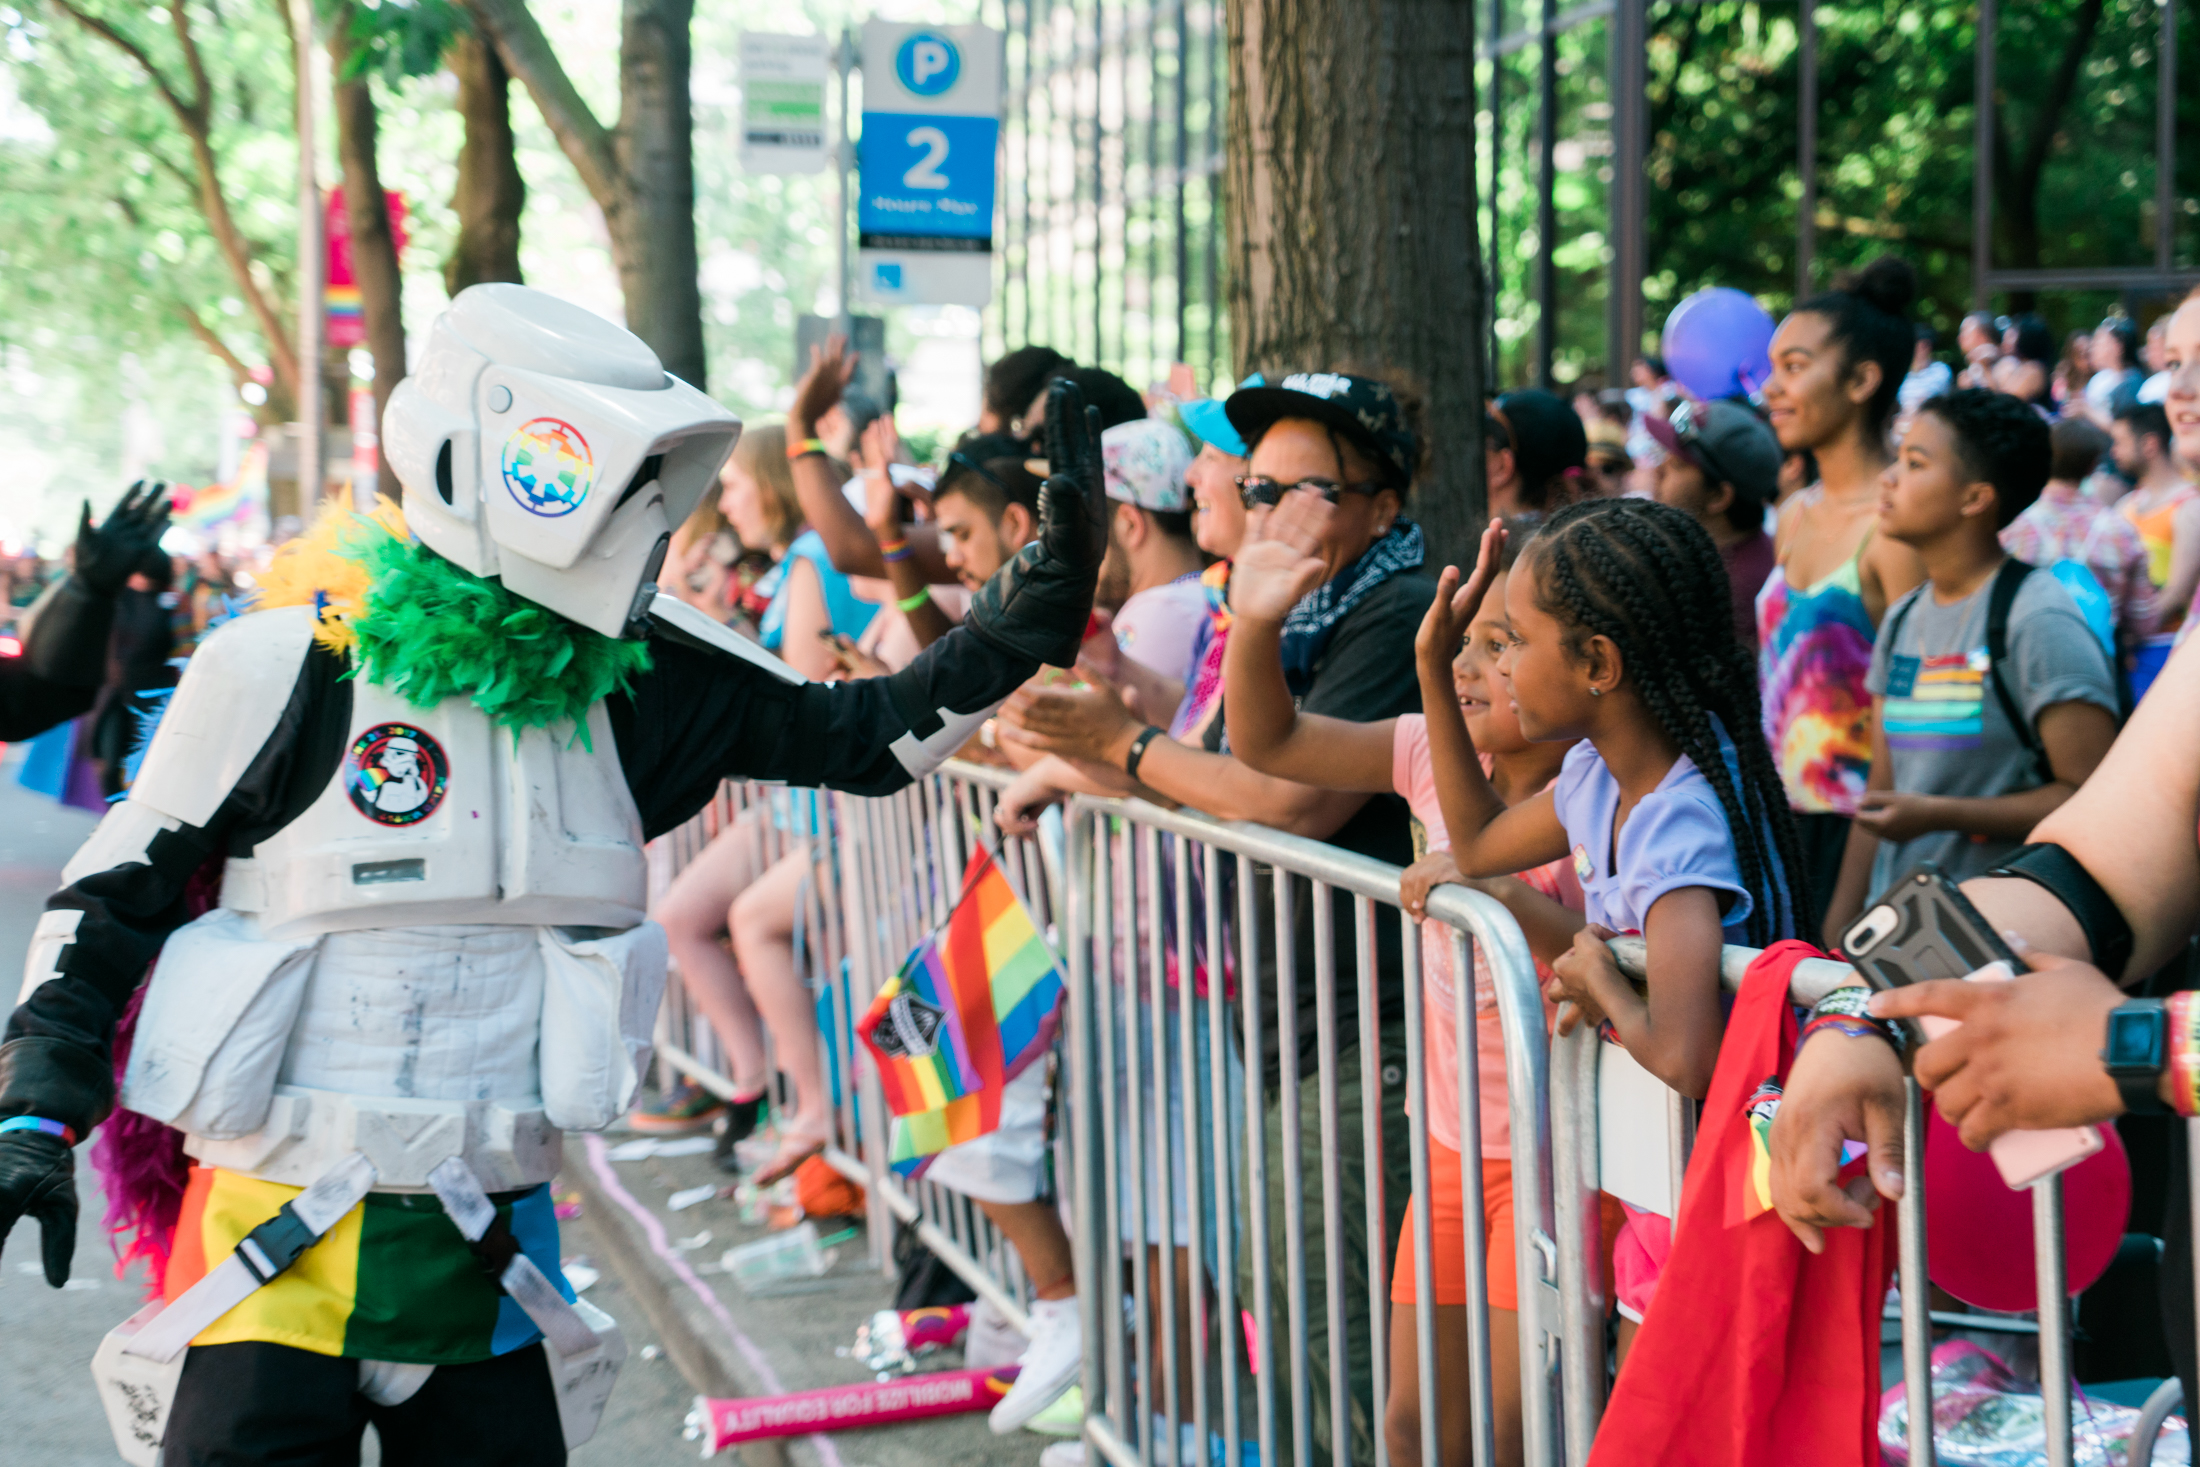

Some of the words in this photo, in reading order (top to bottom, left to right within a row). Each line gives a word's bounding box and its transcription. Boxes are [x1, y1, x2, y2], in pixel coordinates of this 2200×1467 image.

[912, 40, 950, 86] P
[902, 125, 950, 190] 2
[725, 1395, 828, 1434] EQUALITY
[830, 1392, 873, 1419] FOR
[874, 1378, 974, 1412] MOBILIZE
